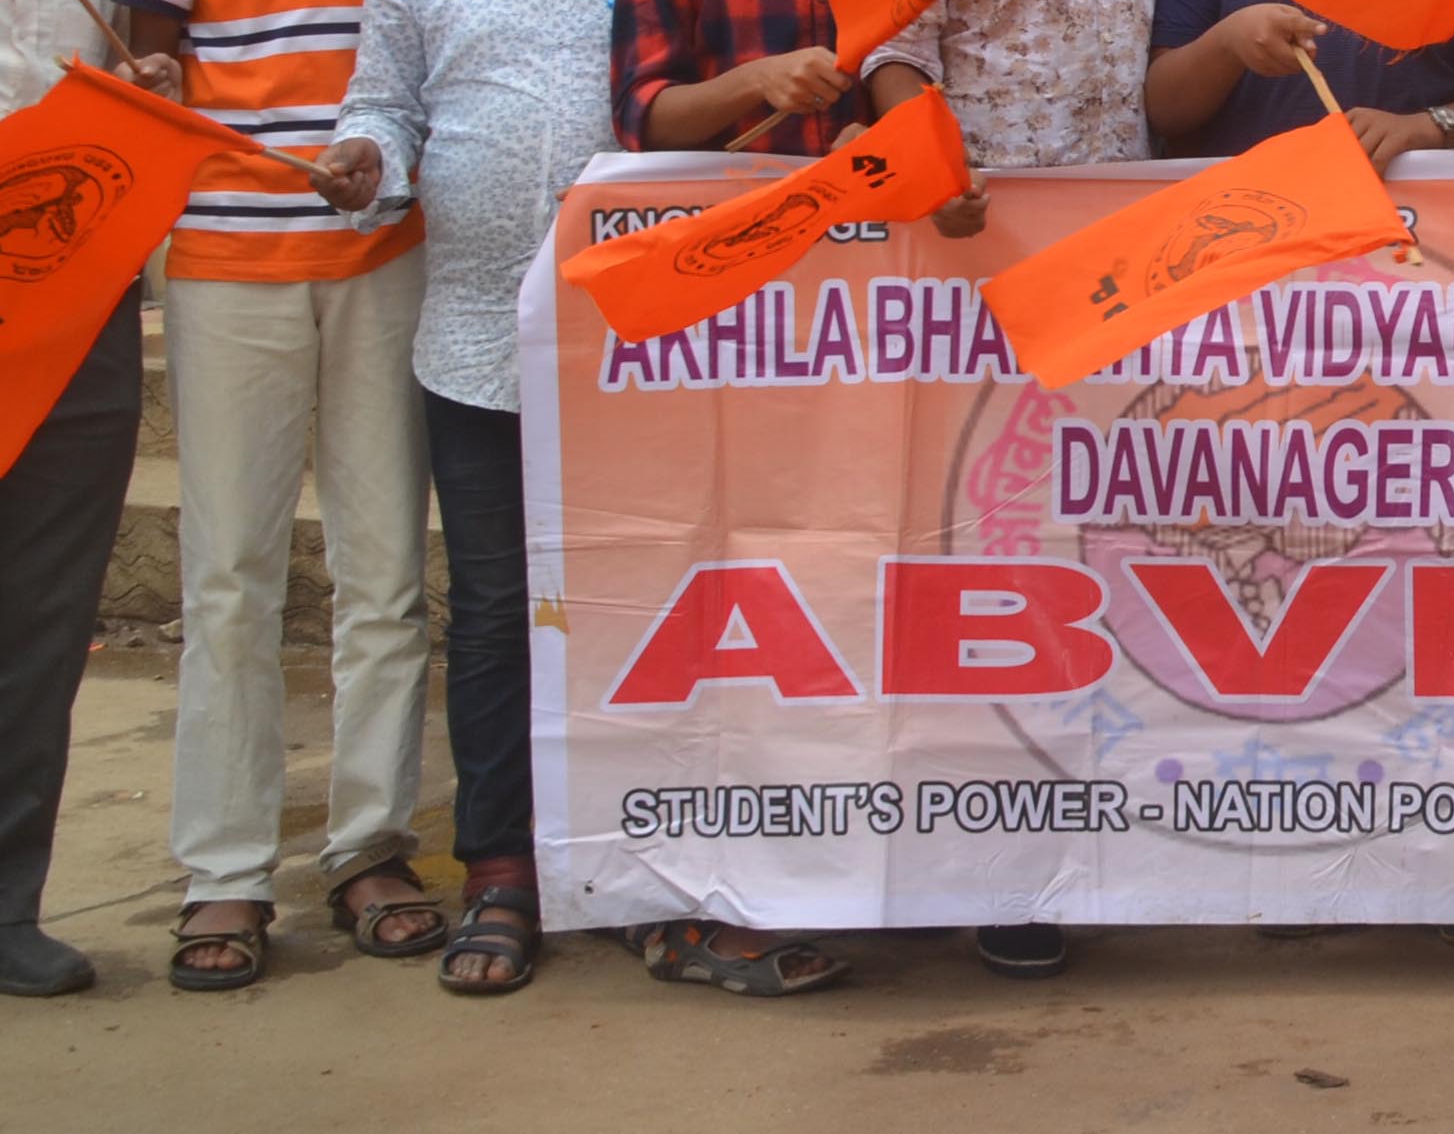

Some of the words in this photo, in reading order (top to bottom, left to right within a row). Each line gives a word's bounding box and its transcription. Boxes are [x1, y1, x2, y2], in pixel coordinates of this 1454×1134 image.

[622, 783, 904, 838] STUDENT'S
[919, 782, 1130, 834] POWER
[1175, 781, 1376, 835] NATION
